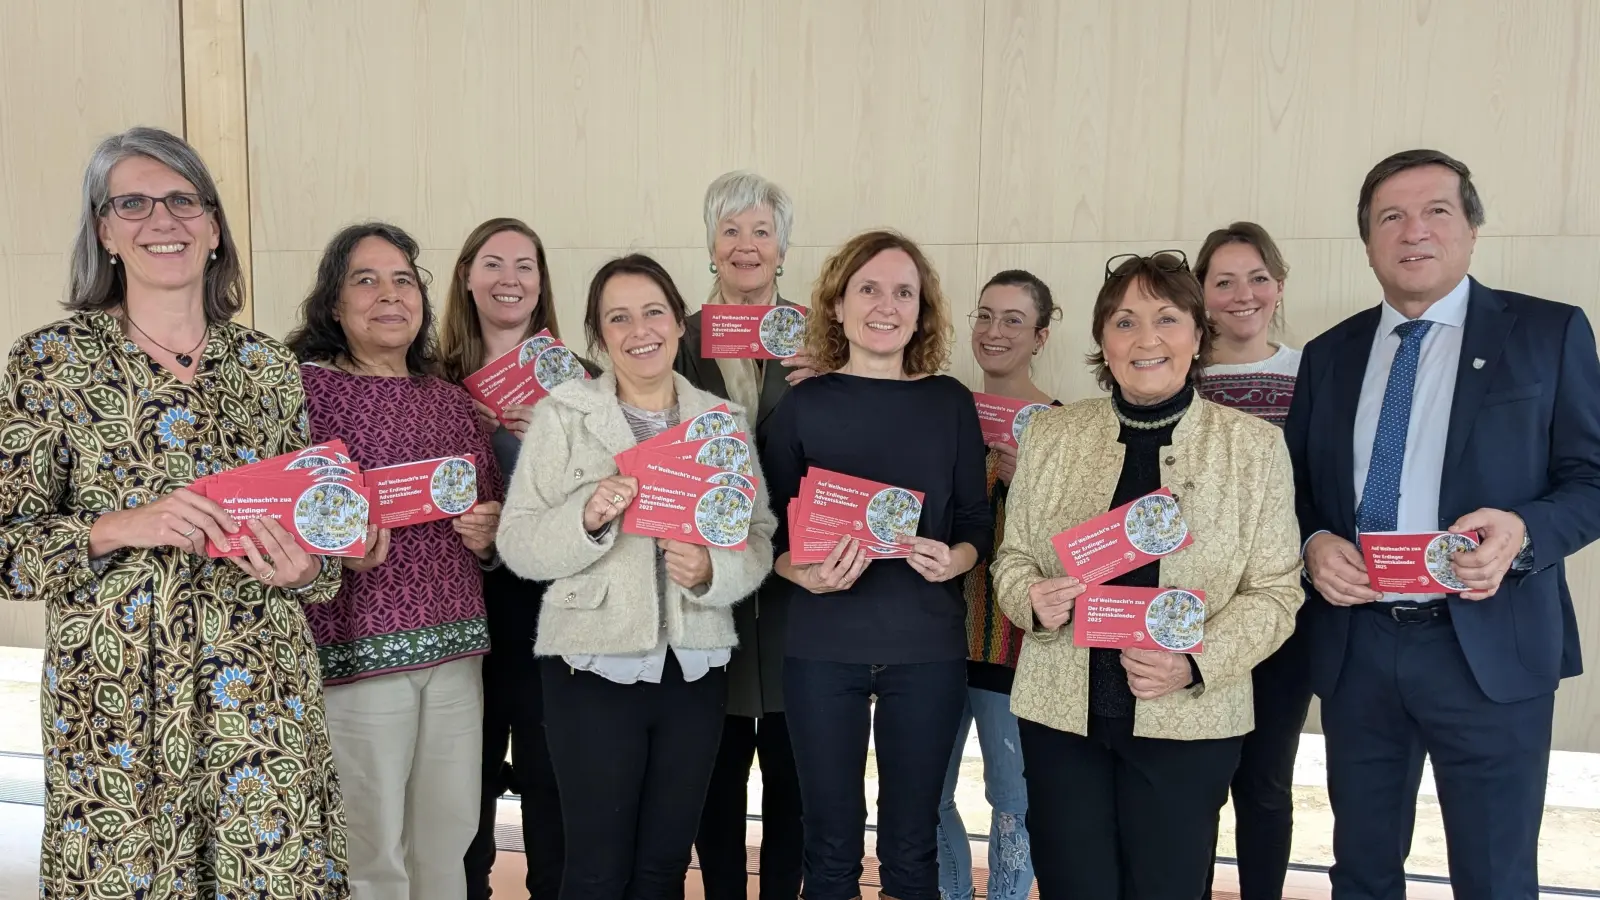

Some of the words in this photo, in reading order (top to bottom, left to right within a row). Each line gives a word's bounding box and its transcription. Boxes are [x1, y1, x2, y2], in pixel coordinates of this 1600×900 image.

[647, 463, 658, 471] Auf
[658, 466, 690, 478] Weihnacht'n
[380, 489, 422, 500] Adventskalender
[390, 485, 411, 493] Erdinger
[653, 485, 686, 496] Weihnacht'n
[828, 483, 859, 495] Weihnacht'n
[651, 494, 676, 503] Erdinger
[814, 494, 859, 508] Adventskalender
[826, 491, 849, 501] Erdinger
[640, 499, 686, 511] Adventskalender
[1068, 540, 1078, 548] Auf
[1077, 526, 1110, 544] Weihnacht'n
[1074, 539, 1118, 561] Adventskalender
[1082, 539, 1105, 553] Erdinger
[1076, 557, 1090, 566] 2025
